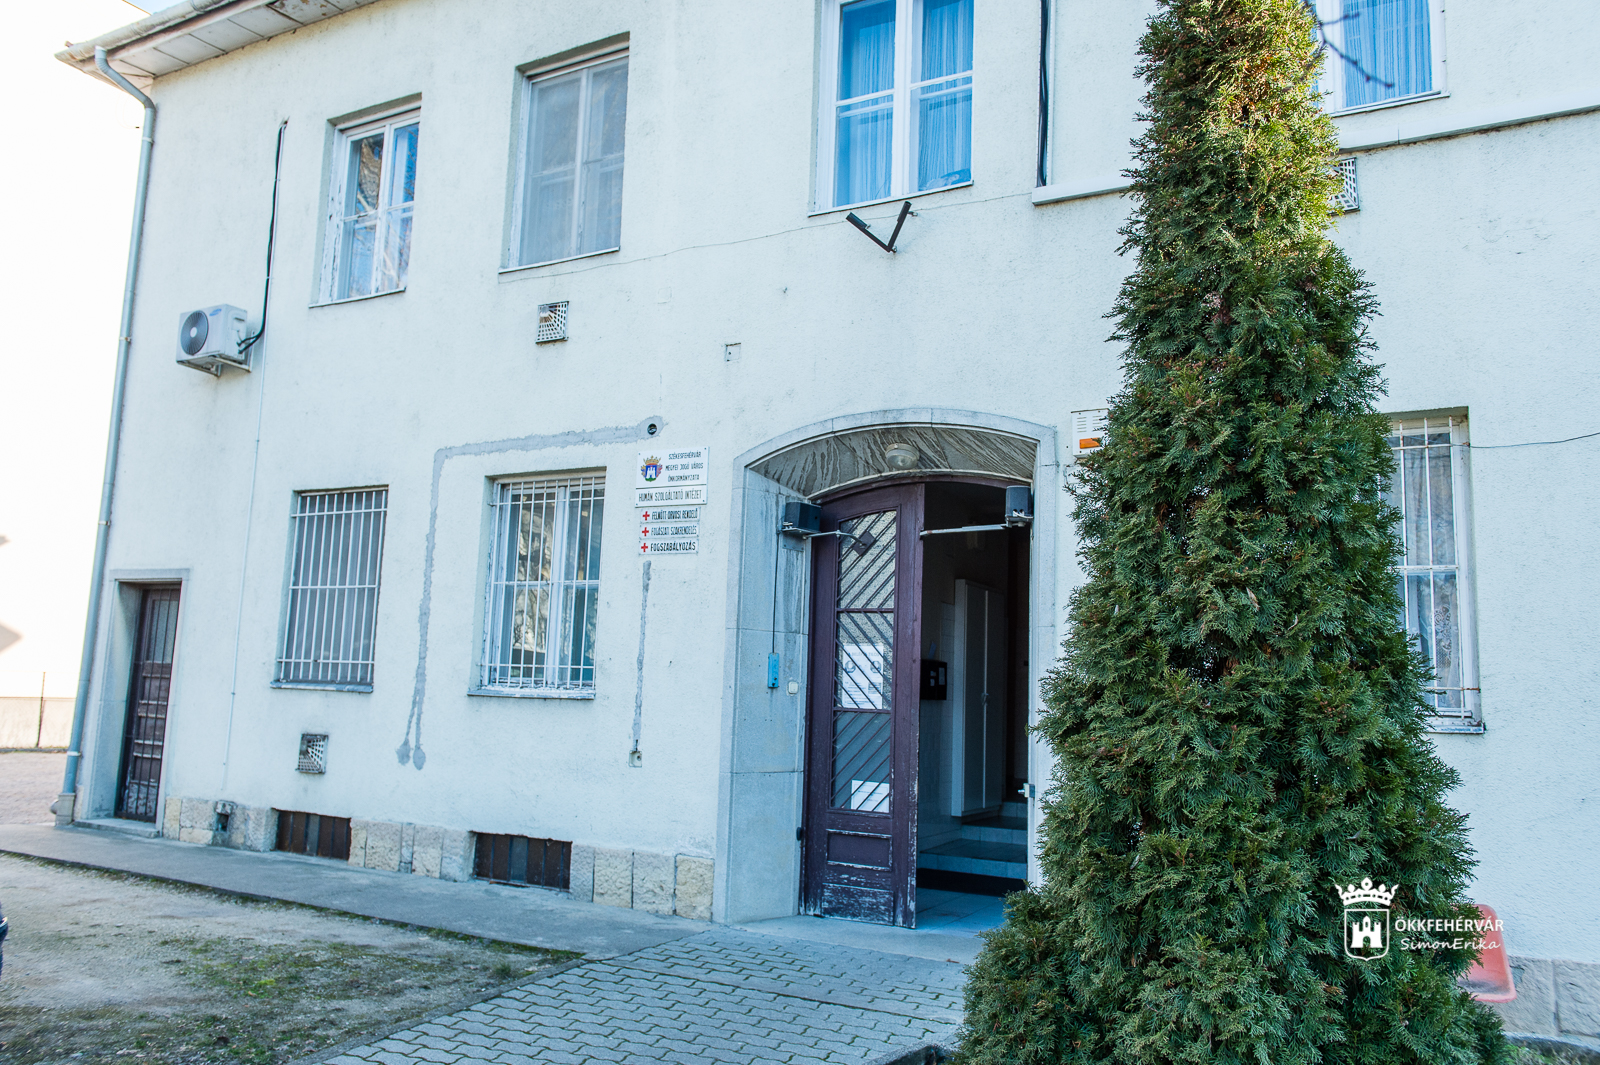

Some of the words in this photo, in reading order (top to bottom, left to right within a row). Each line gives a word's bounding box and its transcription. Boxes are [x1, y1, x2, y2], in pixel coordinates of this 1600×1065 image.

[668, 450, 701, 460] SZÉKESFEHÉRVÁR
[691, 461, 703, 469] VÁROS
[668, 473, 699, 482] ÖNKORMÁNYZATA
[638, 491, 653, 502] HUMÁN
[655, 489, 683, 501] SZOLGÁLTATÓ
[685, 488, 702, 500] INTÉZET
[670, 525, 697, 535] SZAKRENDELÉS
[650, 540, 696, 551] FOGSZABÁLYOZÁS
